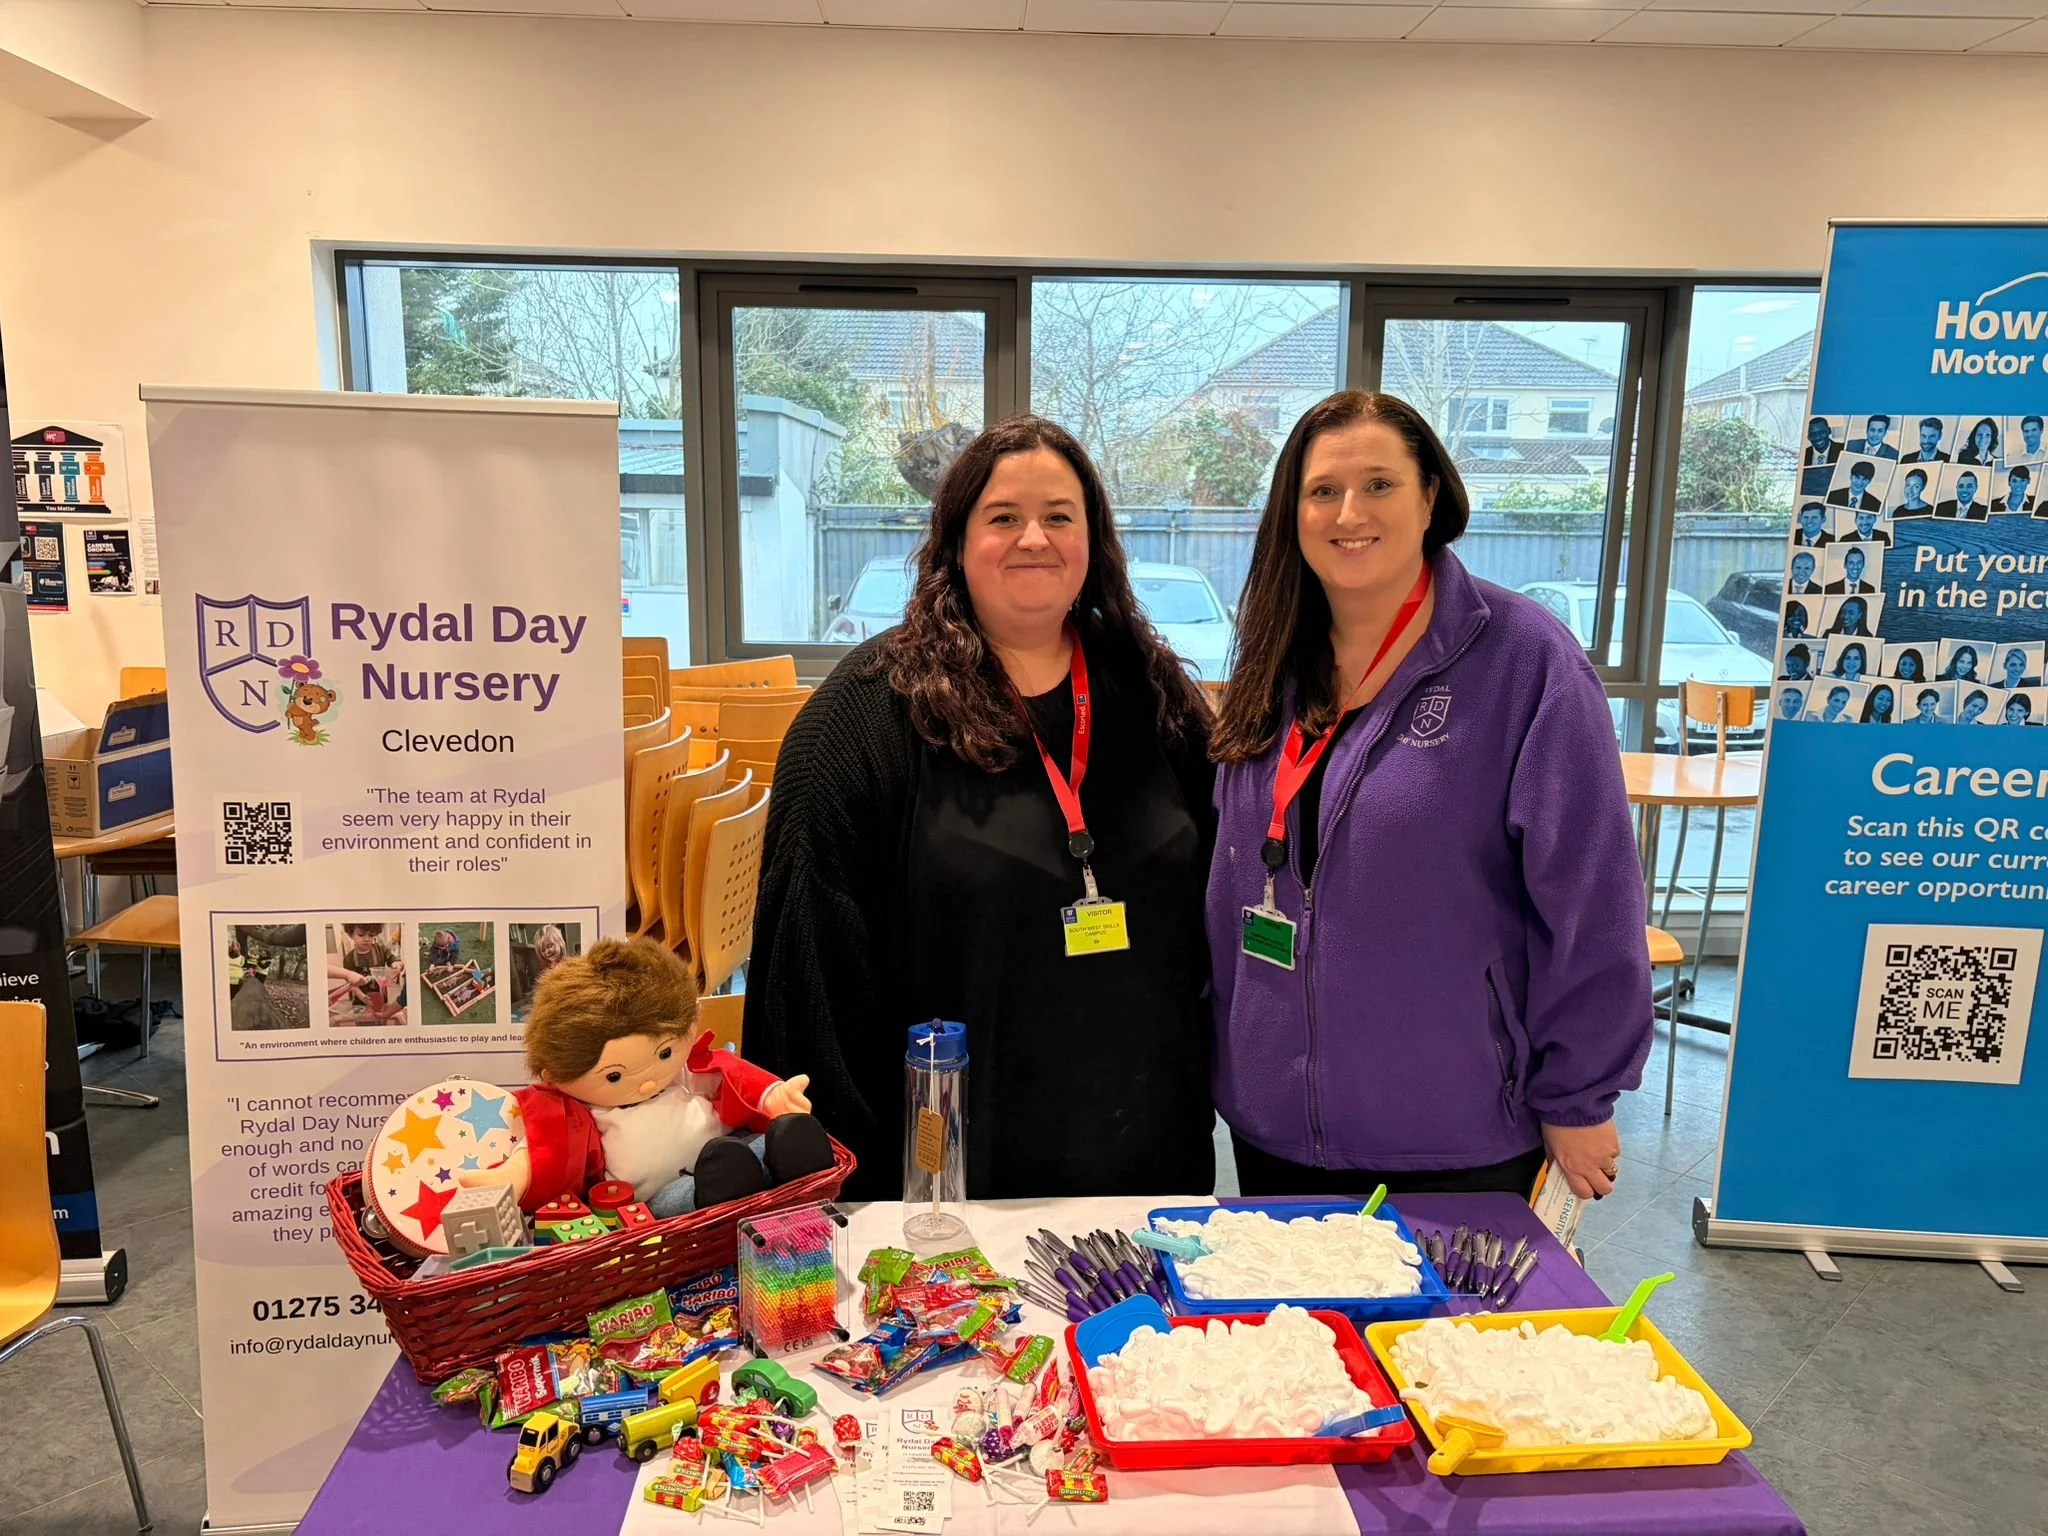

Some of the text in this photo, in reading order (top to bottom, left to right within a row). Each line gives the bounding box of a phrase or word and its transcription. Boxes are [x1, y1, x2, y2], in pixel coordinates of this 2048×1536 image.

[1935, 301, 2048, 341] How
[1931, 349, 2035, 375] Motor
[1914, 545, 2048, 582] Put your
[1898, 582, 1925, 608] in
[1935, 583, 1988, 608] the
[215, 620, 294, 648] R D
[331, 603, 587, 654] Rydal Day
[240, 680, 268, 706] N
[361, 663, 561, 712] Nursery
[1433, 701, 1445, 711] D
[1420, 719, 1432, 729] N
[382, 729, 515, 753] Clevedon
[1410, 732, 1450, 748] NURSERY
[367, 788, 546, 805] "The team at Rydal
[342, 810, 571, 831] seem very happy in their
[1848, 815, 1908, 838] Scan
[1916, 817, 1965, 838] this
[1974, 817, 2020, 843] QR
[322, 833, 592, 851] environment and confident in
[409, 856, 509, 873] their roles"
[1844, 848, 2048, 870] to see our curr
[1824, 879, 1909, 896] career
[1087, 909, 1112, 917] VISITOR
[1926, 988, 1965, 999] SCAN
[1922, 1001, 1962, 1020] ME
[259, 1039, 318, 1049] environment
[320, 1038, 348, 1047] where
[350, 1036, 386, 1046] children
[404, 1035, 458, 1044] enthusiastic
[471, 1034, 489, 1044] play
[491, 1033, 508, 1041] and
[509, 1033, 525, 1041] lea
[227, 1097, 241, 1112] "I
[247, 1095, 313, 1112] cannot
[241, 1117, 296, 1138] Rydal
[302, 1116, 340, 1133] Day
[221, 1136, 364, 1159] enough and no
[249, 1162, 268, 1178] of
[272, 1159, 330, 1177] words
[250, 1182, 304, 1200] credit
[232, 1205, 313, 1223] amazing
[273, 1227, 314, 1243] they
[681, 1286, 738, 1308] HARIBO
[253, 1296, 340, 1321] 01275
[597, 1303, 656, 1334] HARIBO
[507, 1354, 548, 1408] HARIBO Supermix
[1060, 1488, 1097, 1497] DRUMSTICK
